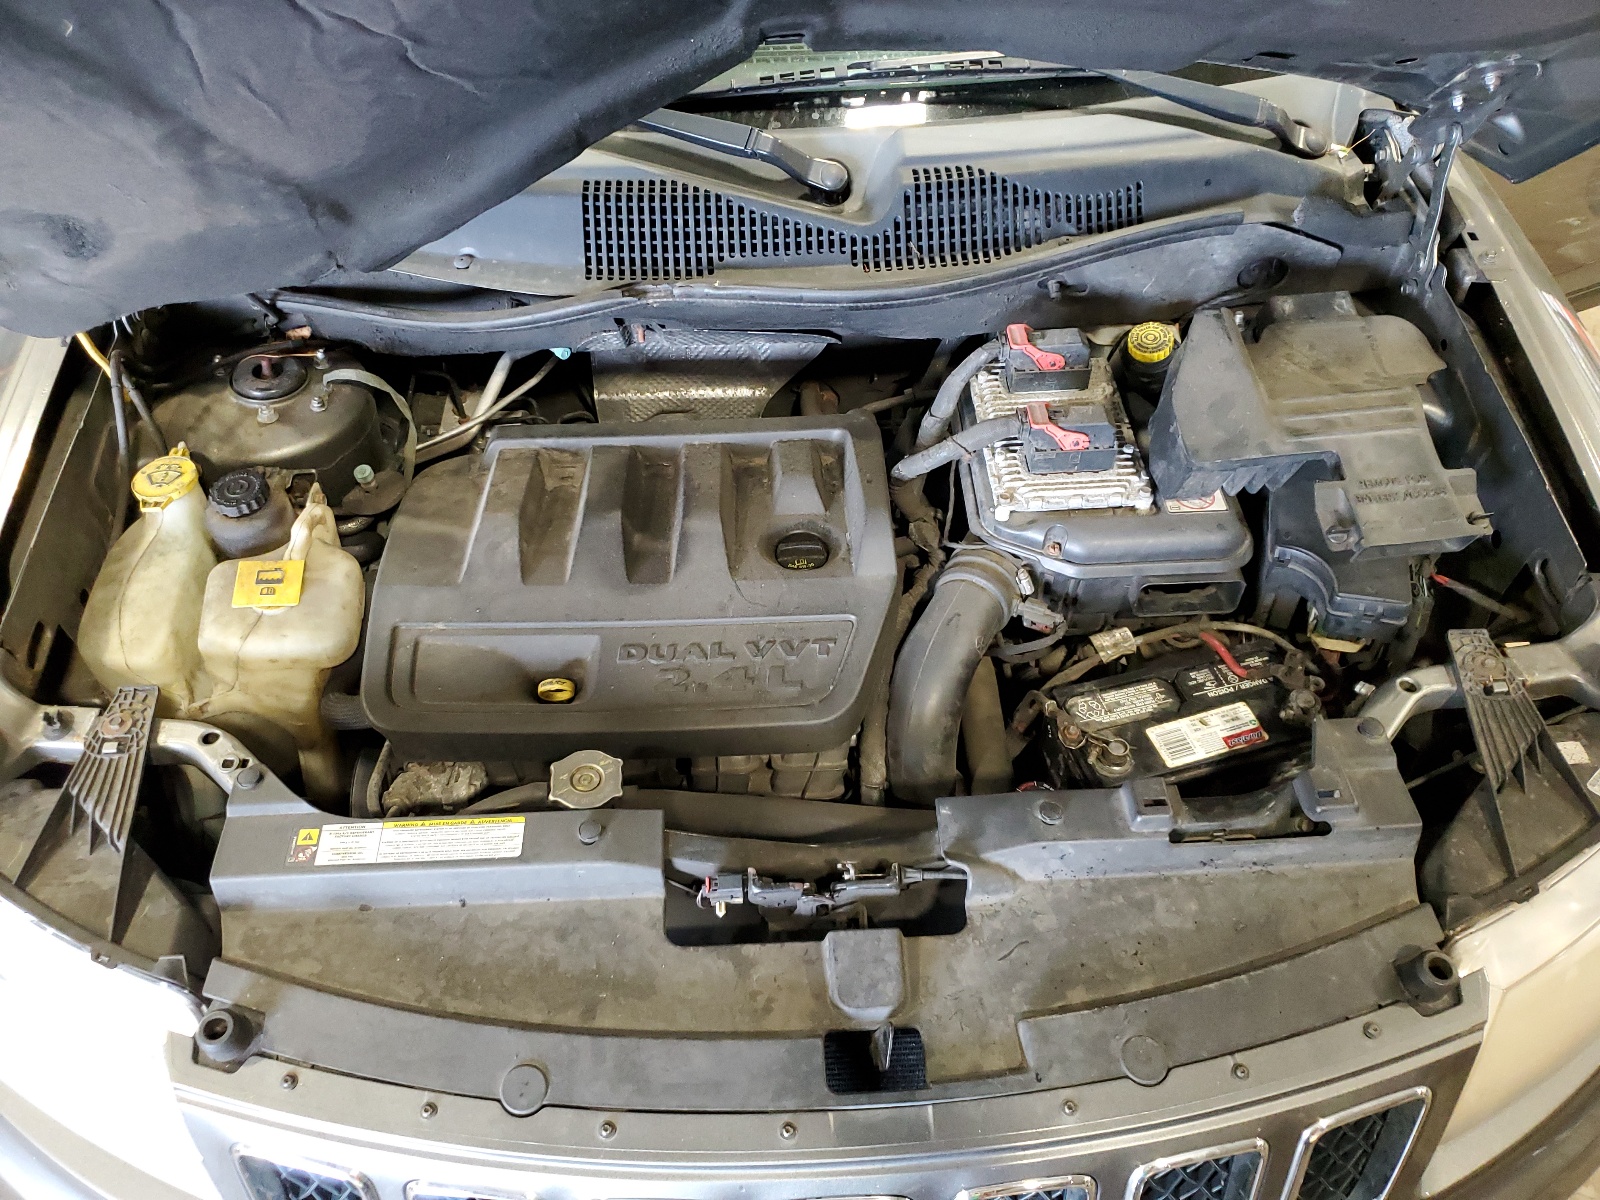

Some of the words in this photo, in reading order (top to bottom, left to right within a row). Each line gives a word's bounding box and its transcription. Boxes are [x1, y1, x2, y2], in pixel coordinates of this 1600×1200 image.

[617, 641, 736, 664] DUAL
[744, 636, 838, 660] VVT
[654, 664, 803, 692] 2.4L
[1238, 677, 1269, 690] DANGER
[1207, 684, 1236, 698] POISON
[1228, 729, 1263, 748] Duralast
